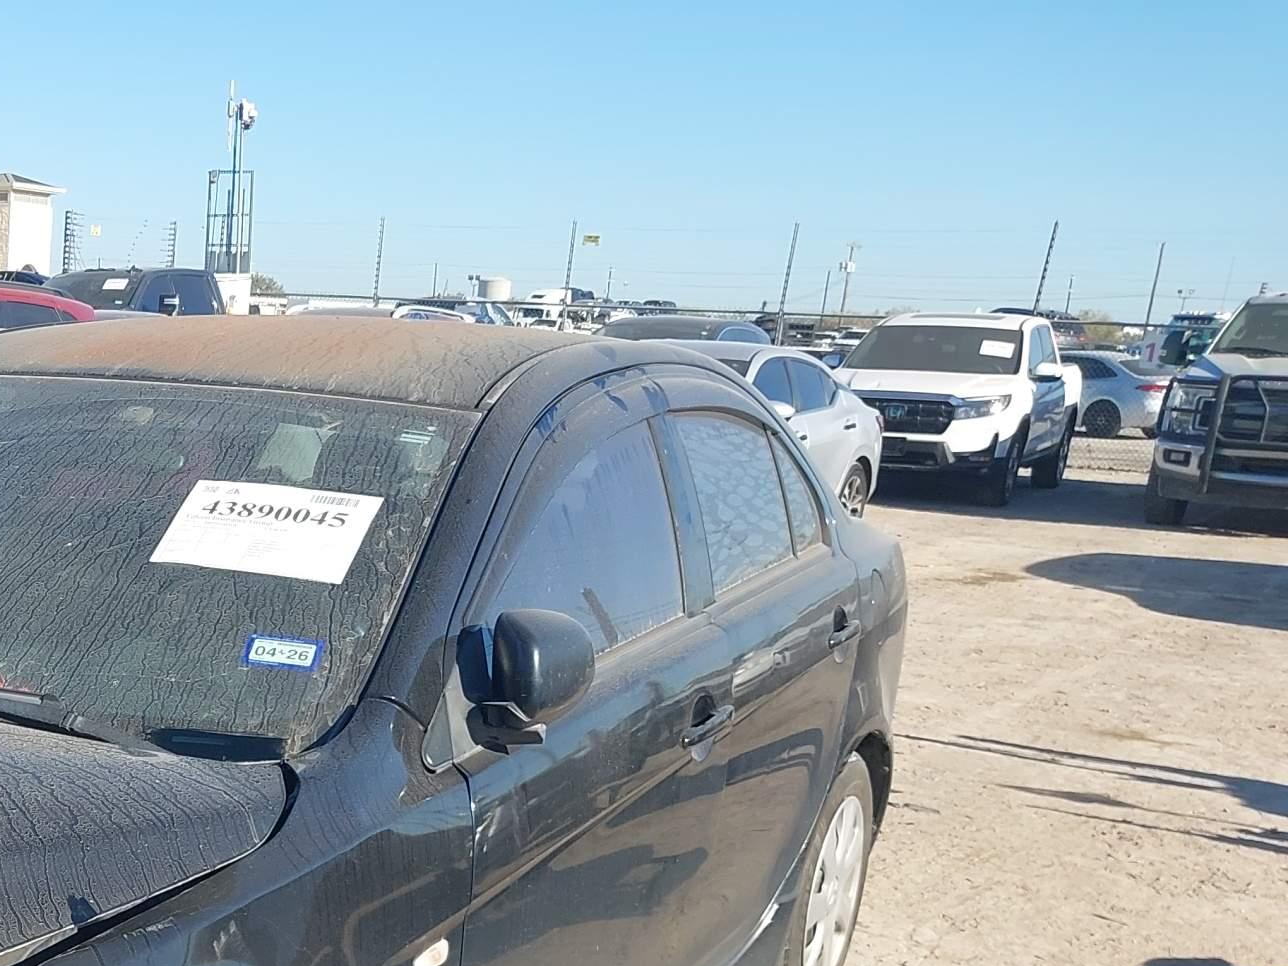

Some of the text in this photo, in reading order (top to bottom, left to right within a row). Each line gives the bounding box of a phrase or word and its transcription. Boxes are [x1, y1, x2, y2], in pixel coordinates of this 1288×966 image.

[201, 499, 350, 529] 43890045
[254, 645, 310, 662] 04 26
